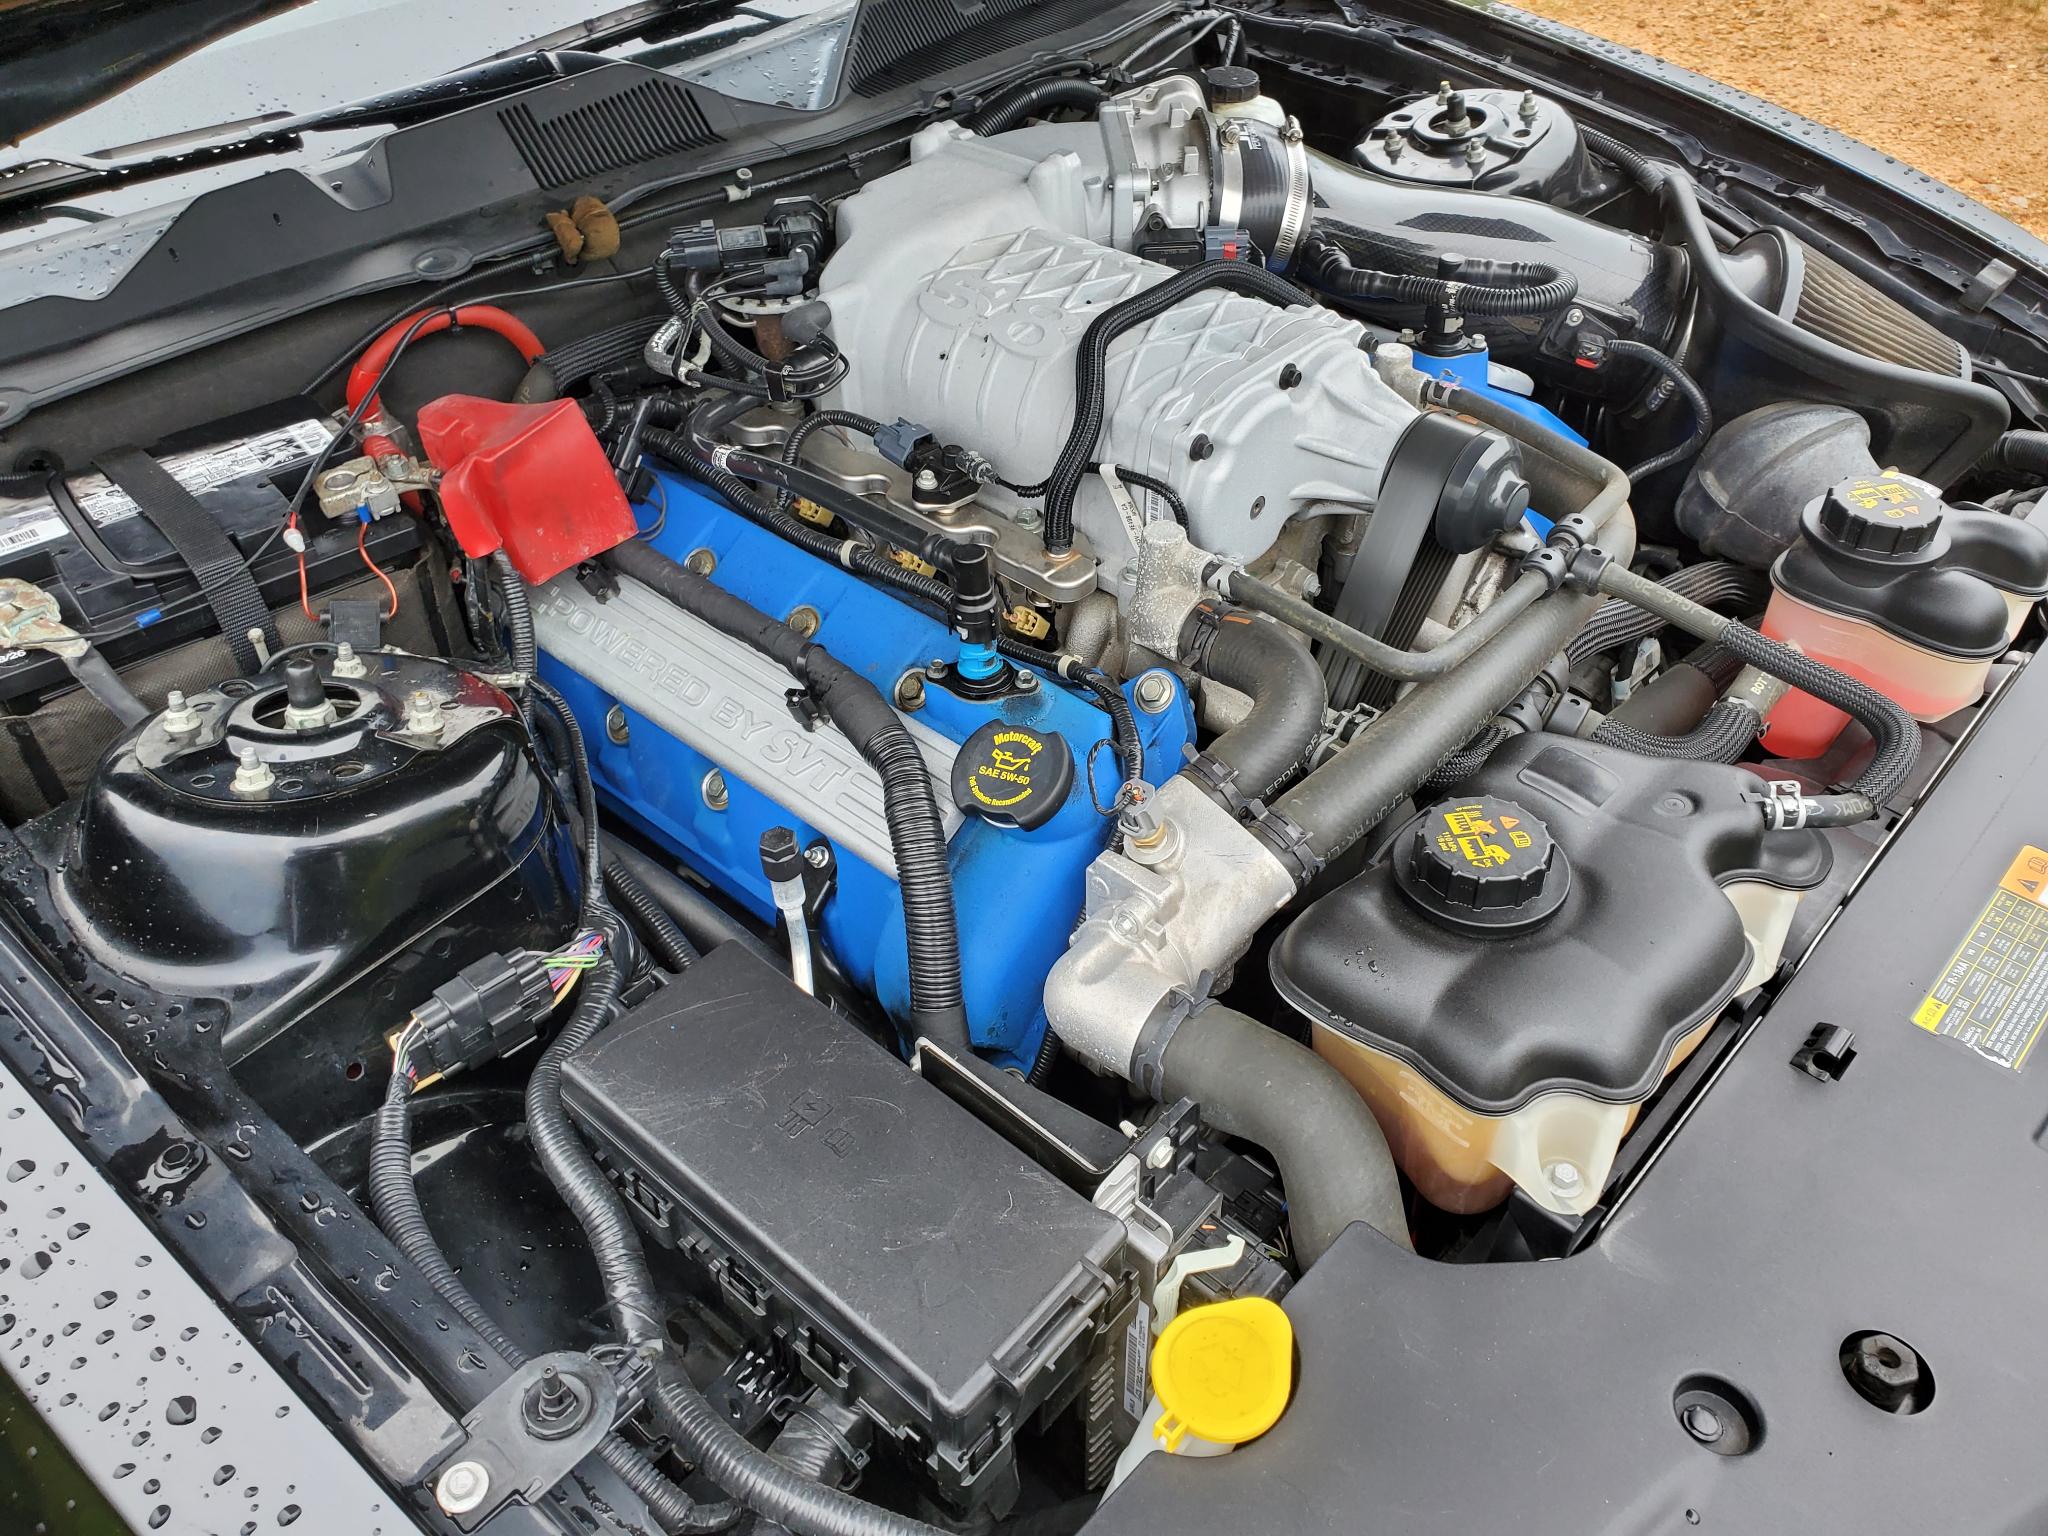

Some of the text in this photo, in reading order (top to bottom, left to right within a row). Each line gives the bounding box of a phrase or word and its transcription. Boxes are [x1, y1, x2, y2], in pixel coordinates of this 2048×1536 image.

[548, 594, 852, 792] POWERED BY SVT
[993, 731, 1044, 756] Motorcraft
[978, 765, 1031, 785] SAE 5W-50
[991, 787, 1033, 806] Recommended
